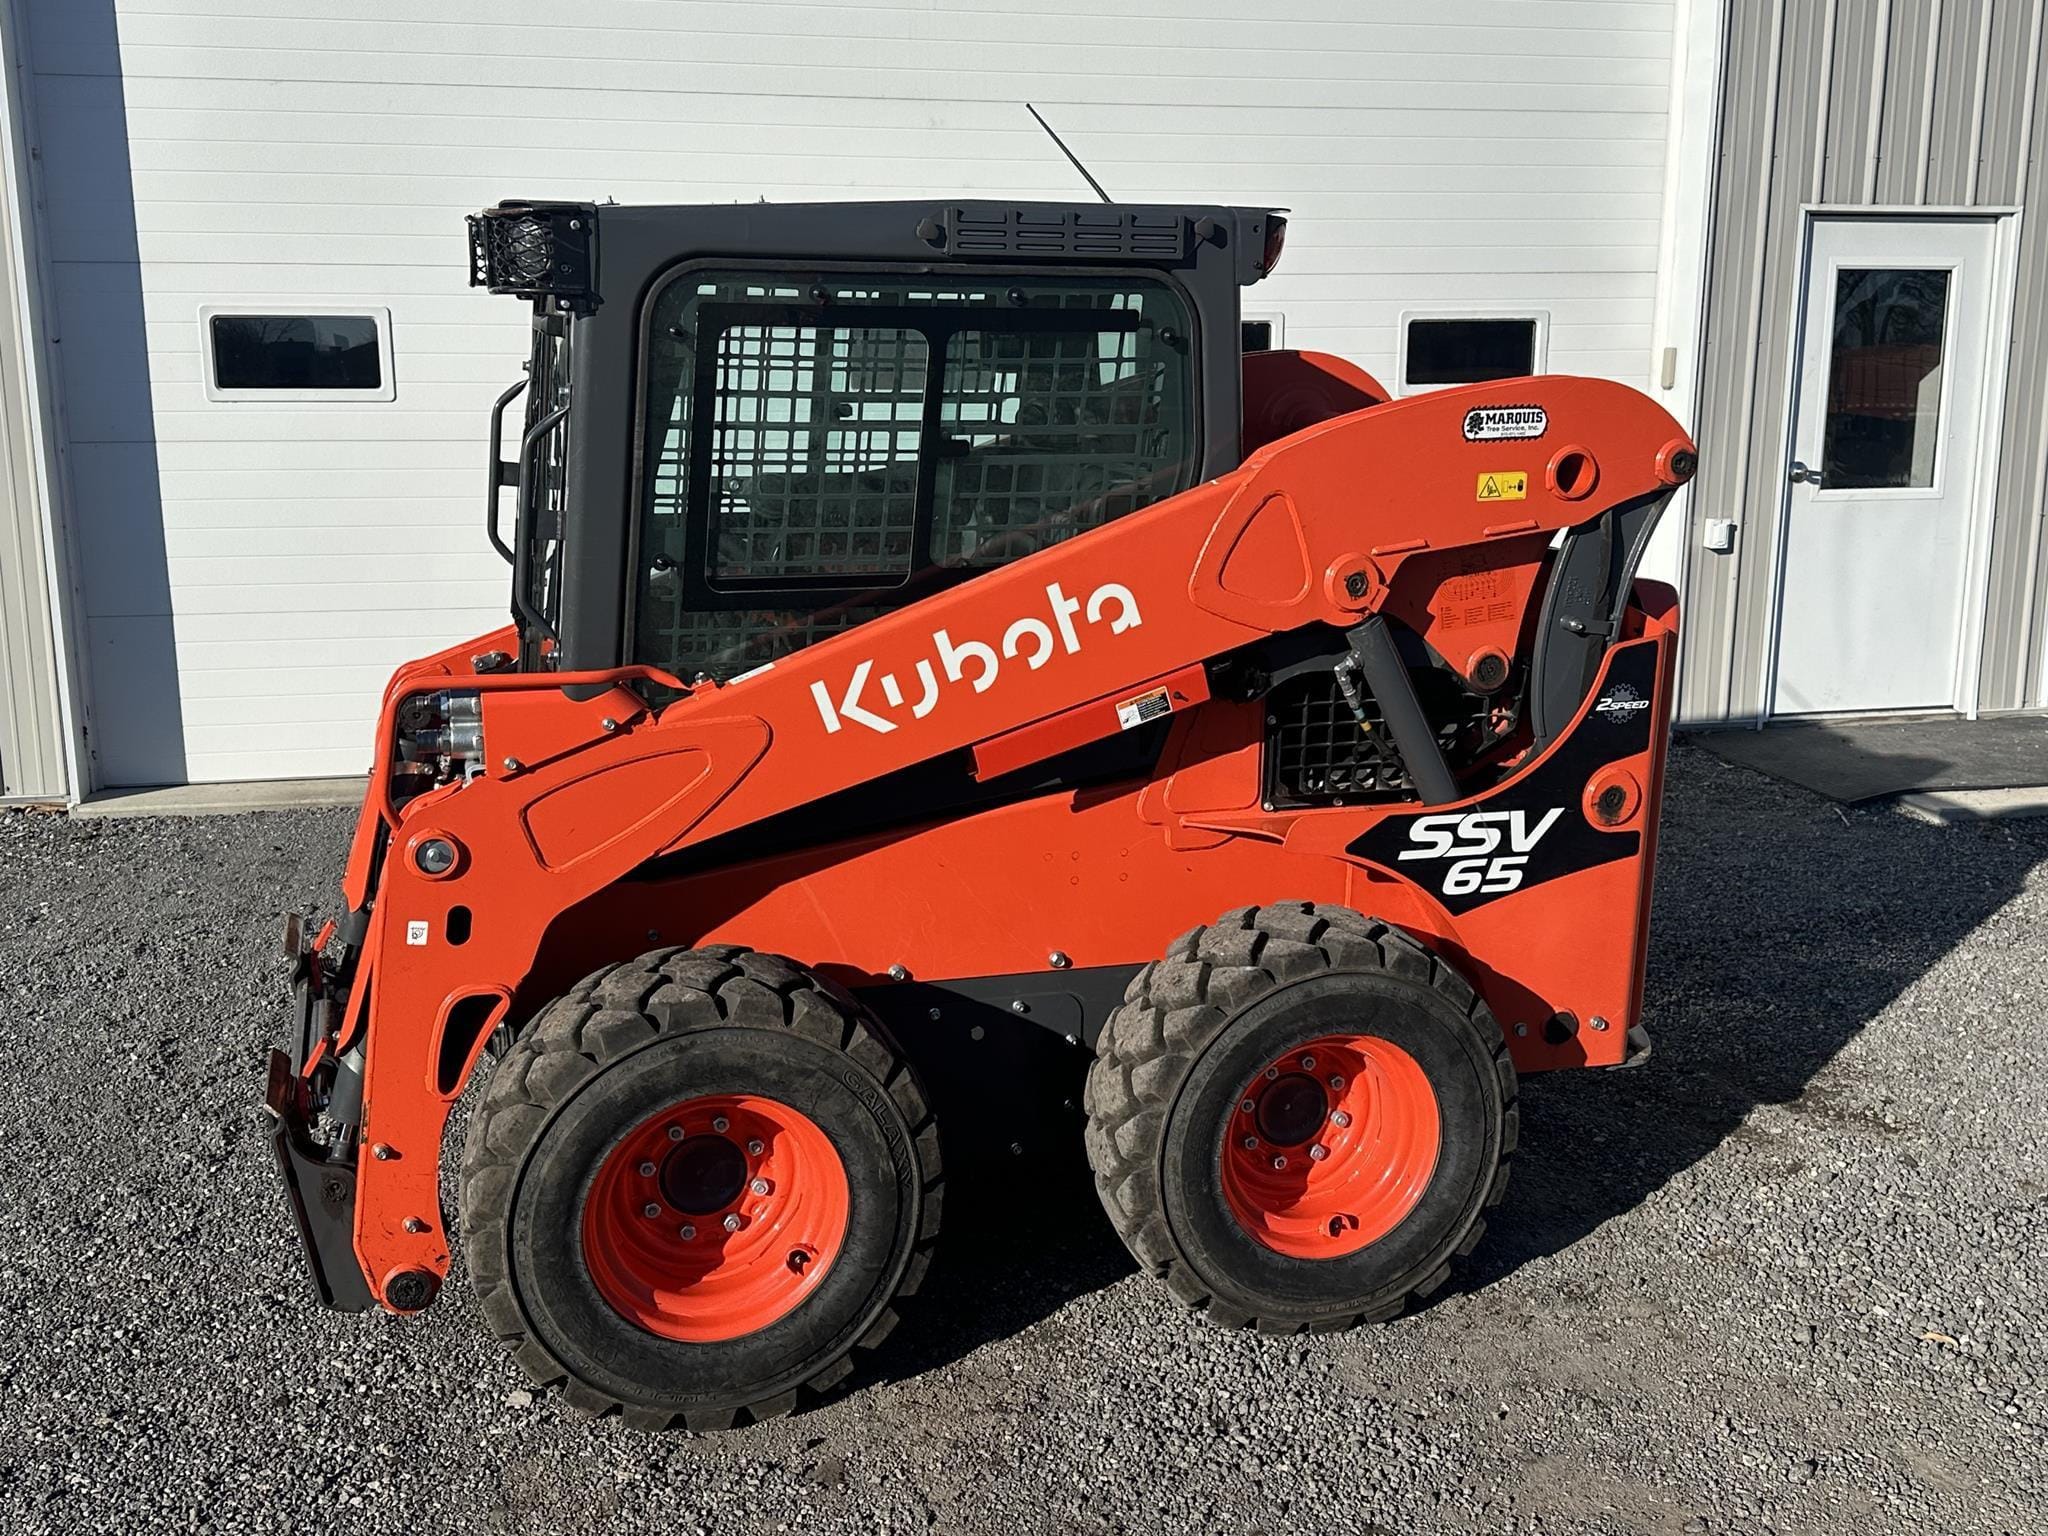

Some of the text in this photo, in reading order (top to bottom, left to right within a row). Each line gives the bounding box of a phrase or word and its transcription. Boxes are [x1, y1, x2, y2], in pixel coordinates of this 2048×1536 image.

[1485, 411, 1543, 425] MARQUIS
[809, 582, 1143, 734] Kubota
[1397, 807, 1566, 861] SSV
[1442, 855, 1530, 895] 65
[842, 1069, 913, 1189] GALAXY
